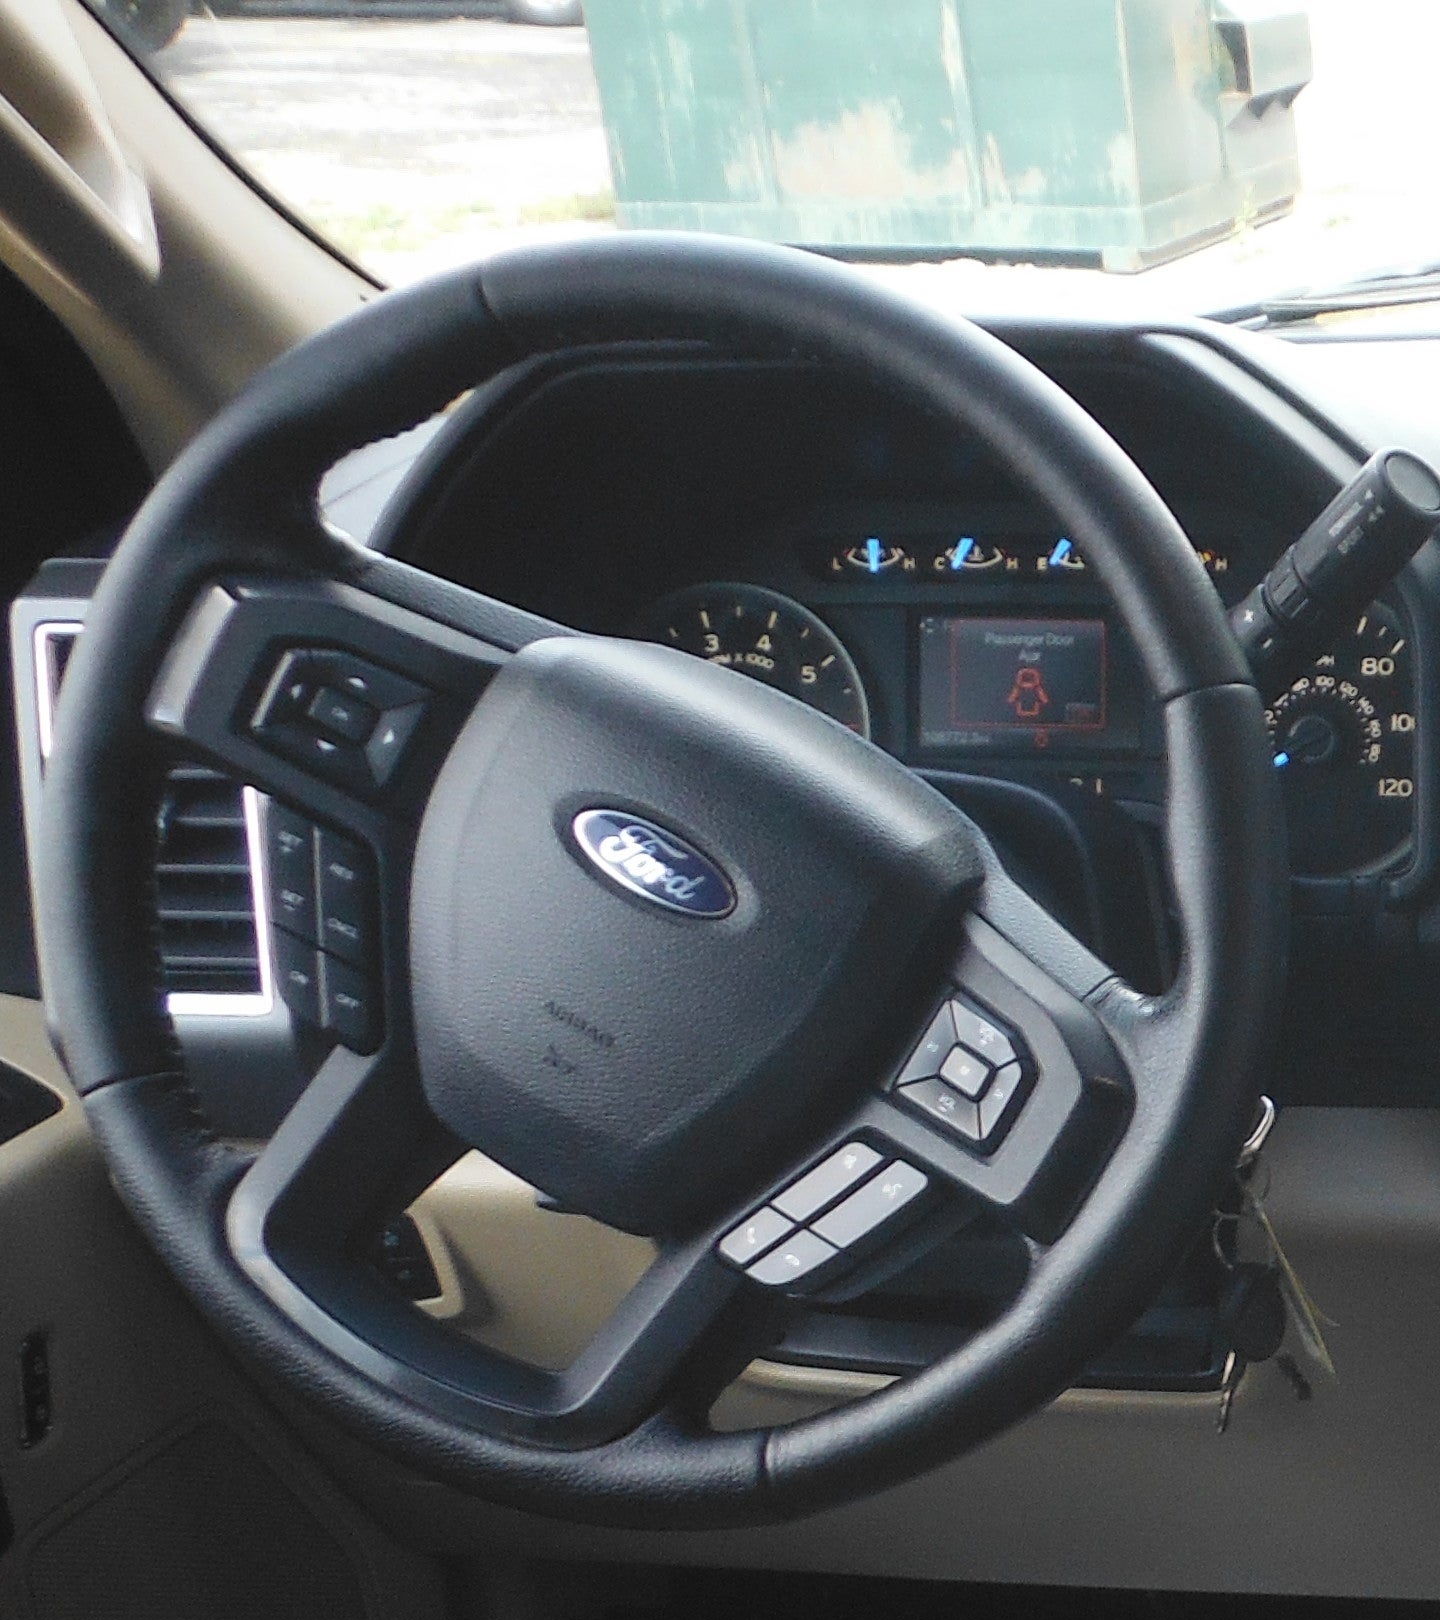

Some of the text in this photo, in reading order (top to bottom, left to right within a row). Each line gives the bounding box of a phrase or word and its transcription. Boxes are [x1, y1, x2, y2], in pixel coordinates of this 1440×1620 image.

[904, 557, 916, 571] H
[934, 556, 946, 570] C
[1007, 557, 1019, 571] H
[1037, 556, 1048, 570] E
[1215, 557, 1229, 571] H
[703, 633, 720, 653] 3
[756, 633, 773, 652] 4
[800, 664, 818, 684] 5
[1360, 657, 1395, 677] 80
[1377, 778, 1414, 798] 120
[599, 824, 707, 901] Ford
